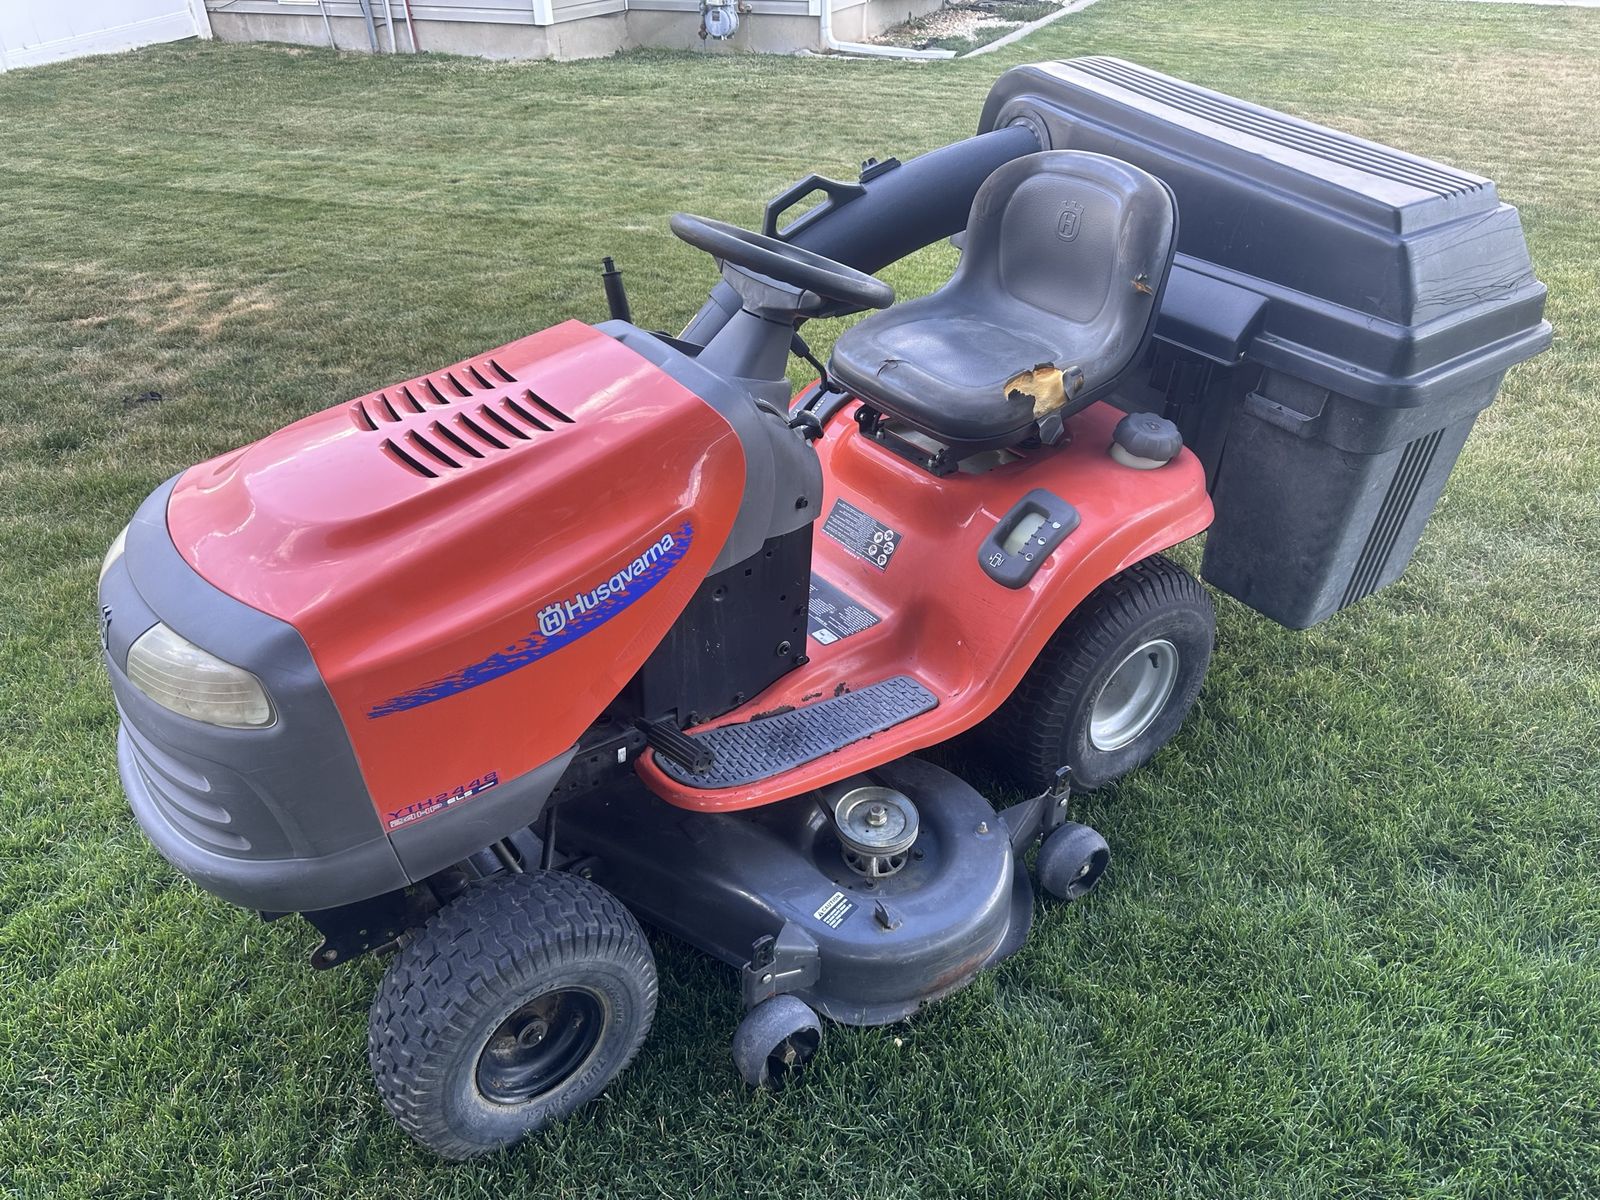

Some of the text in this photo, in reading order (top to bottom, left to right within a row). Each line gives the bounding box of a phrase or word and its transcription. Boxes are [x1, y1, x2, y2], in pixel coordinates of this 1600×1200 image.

[564, 533, 676, 621] Husqvarna
[388, 771, 497, 819] YTH2448
[820, 894, 841, 912] CAUTION
